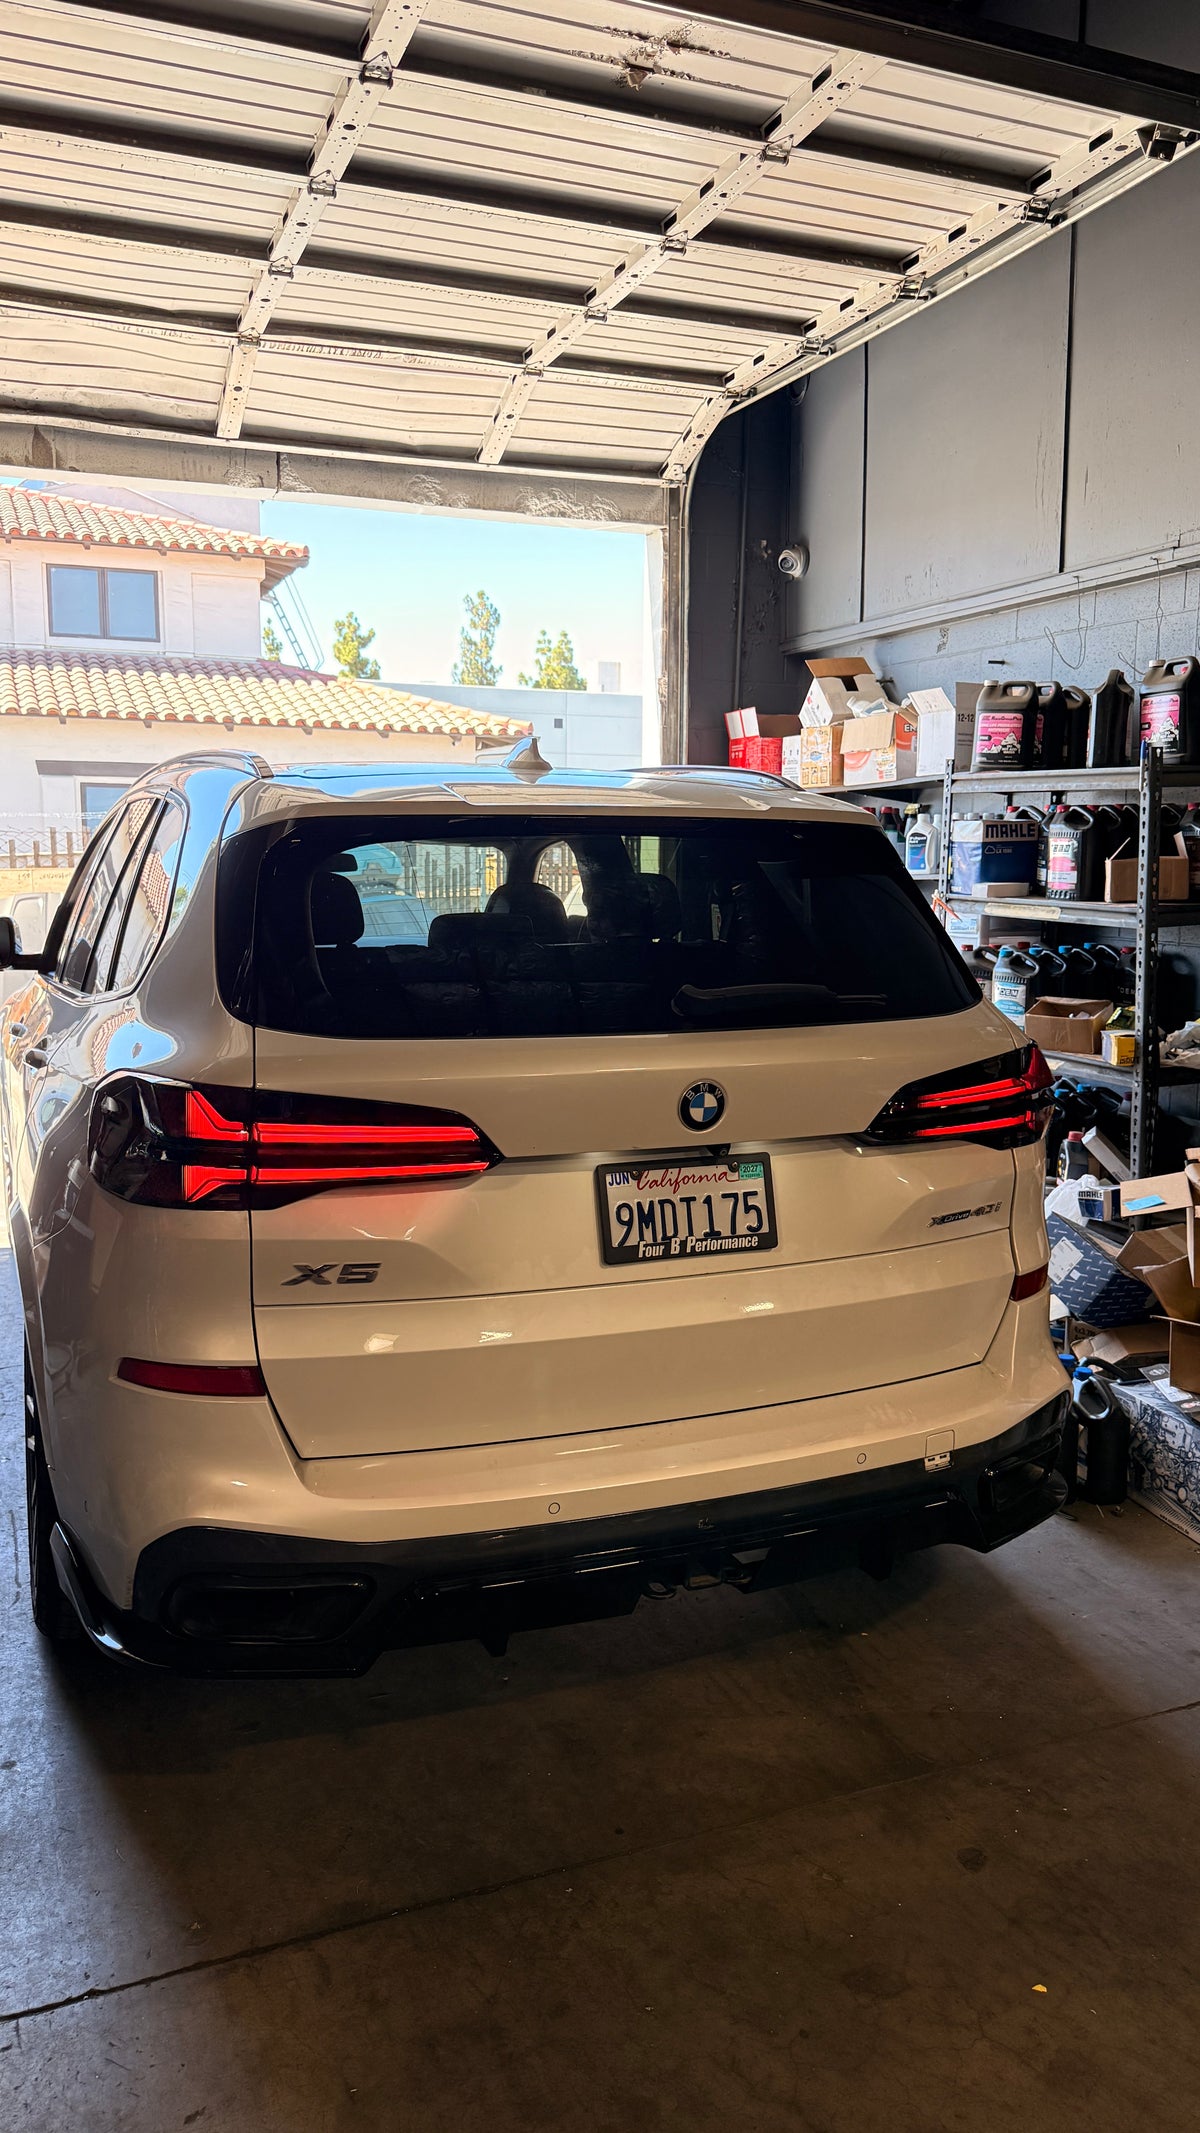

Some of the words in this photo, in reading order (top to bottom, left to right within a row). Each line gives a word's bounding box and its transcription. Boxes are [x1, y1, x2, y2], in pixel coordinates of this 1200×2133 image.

[985, 823, 1035, 838] MAHLE
[685, 1083, 723, 1100] BMW
[742, 1164, 757, 1173] 2027
[608, 1172, 630, 1187] JUN
[636, 1165, 739, 1194] California
[1078, 1191, 1103, 1199] MAHLE
[616, 1190, 763, 1247] 9MDT175
[638, 1241, 665, 1258] Four
[670, 1237, 681, 1255] B
[686, 1235, 759, 1253] Performance
[280, 1262, 382, 1286] X5
